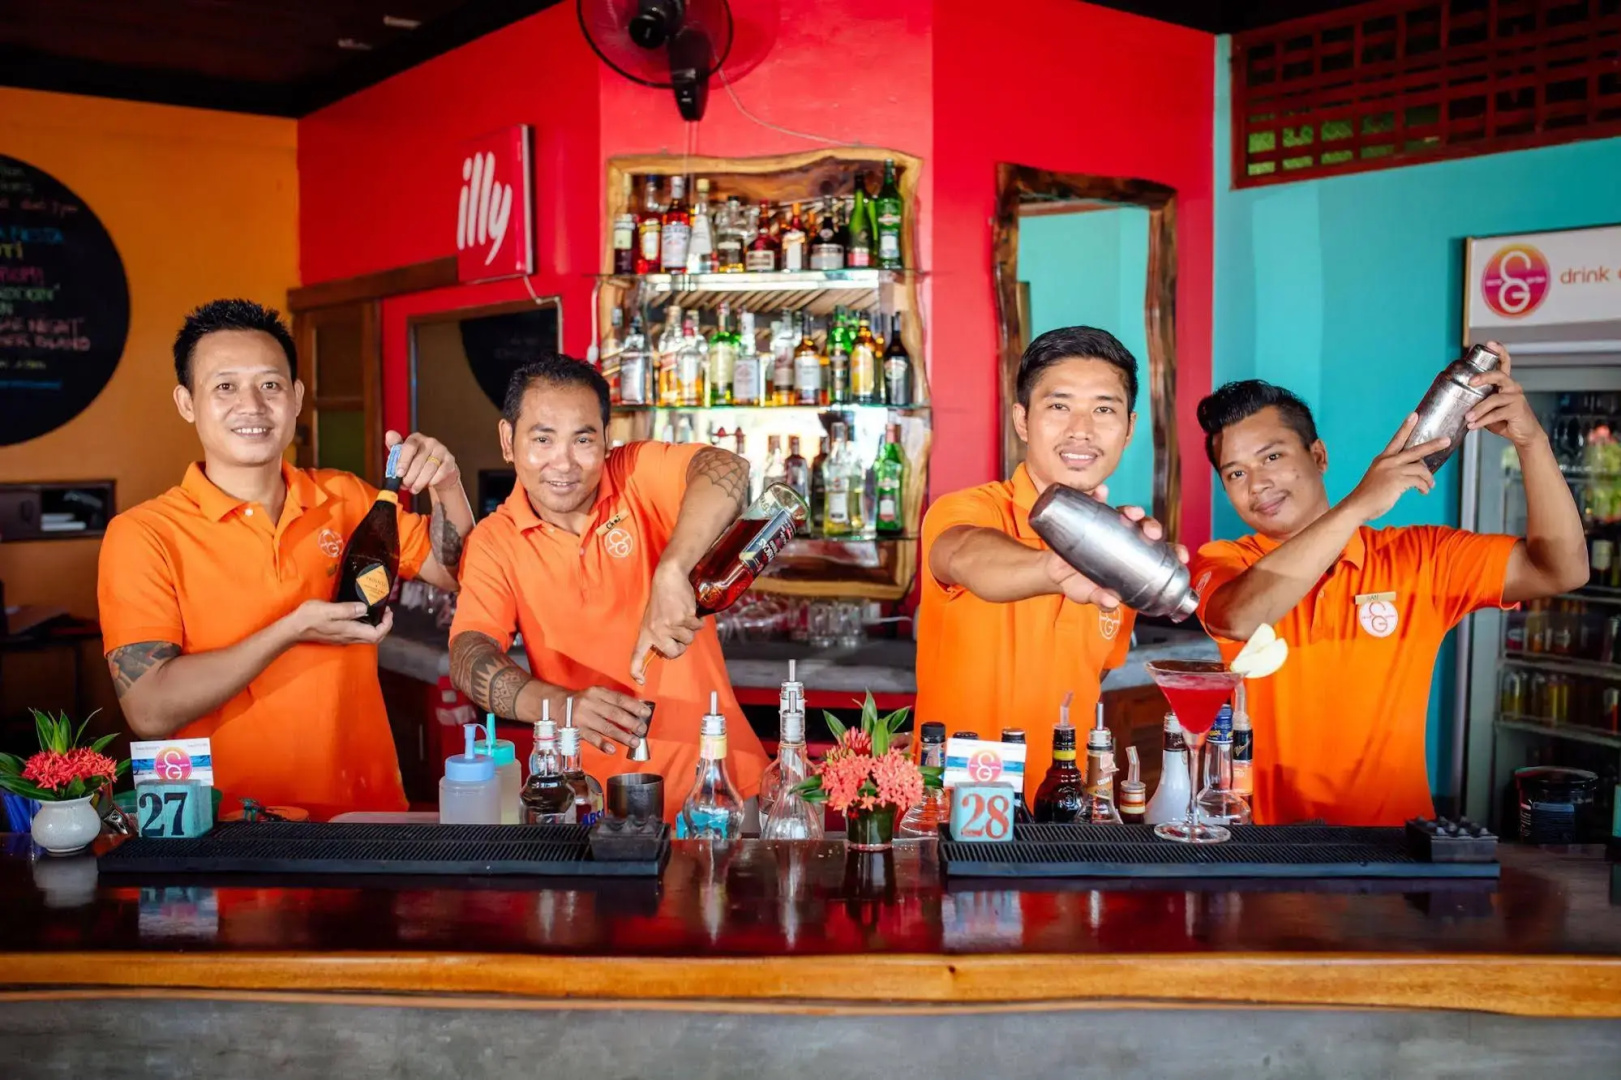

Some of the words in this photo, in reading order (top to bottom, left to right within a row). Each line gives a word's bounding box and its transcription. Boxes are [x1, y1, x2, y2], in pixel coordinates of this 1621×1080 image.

[457, 151, 513, 266] illy
[1560, 265, 1610, 285] drink
[139, 792, 188, 837] 27
[961, 793, 1009, 840] 28
